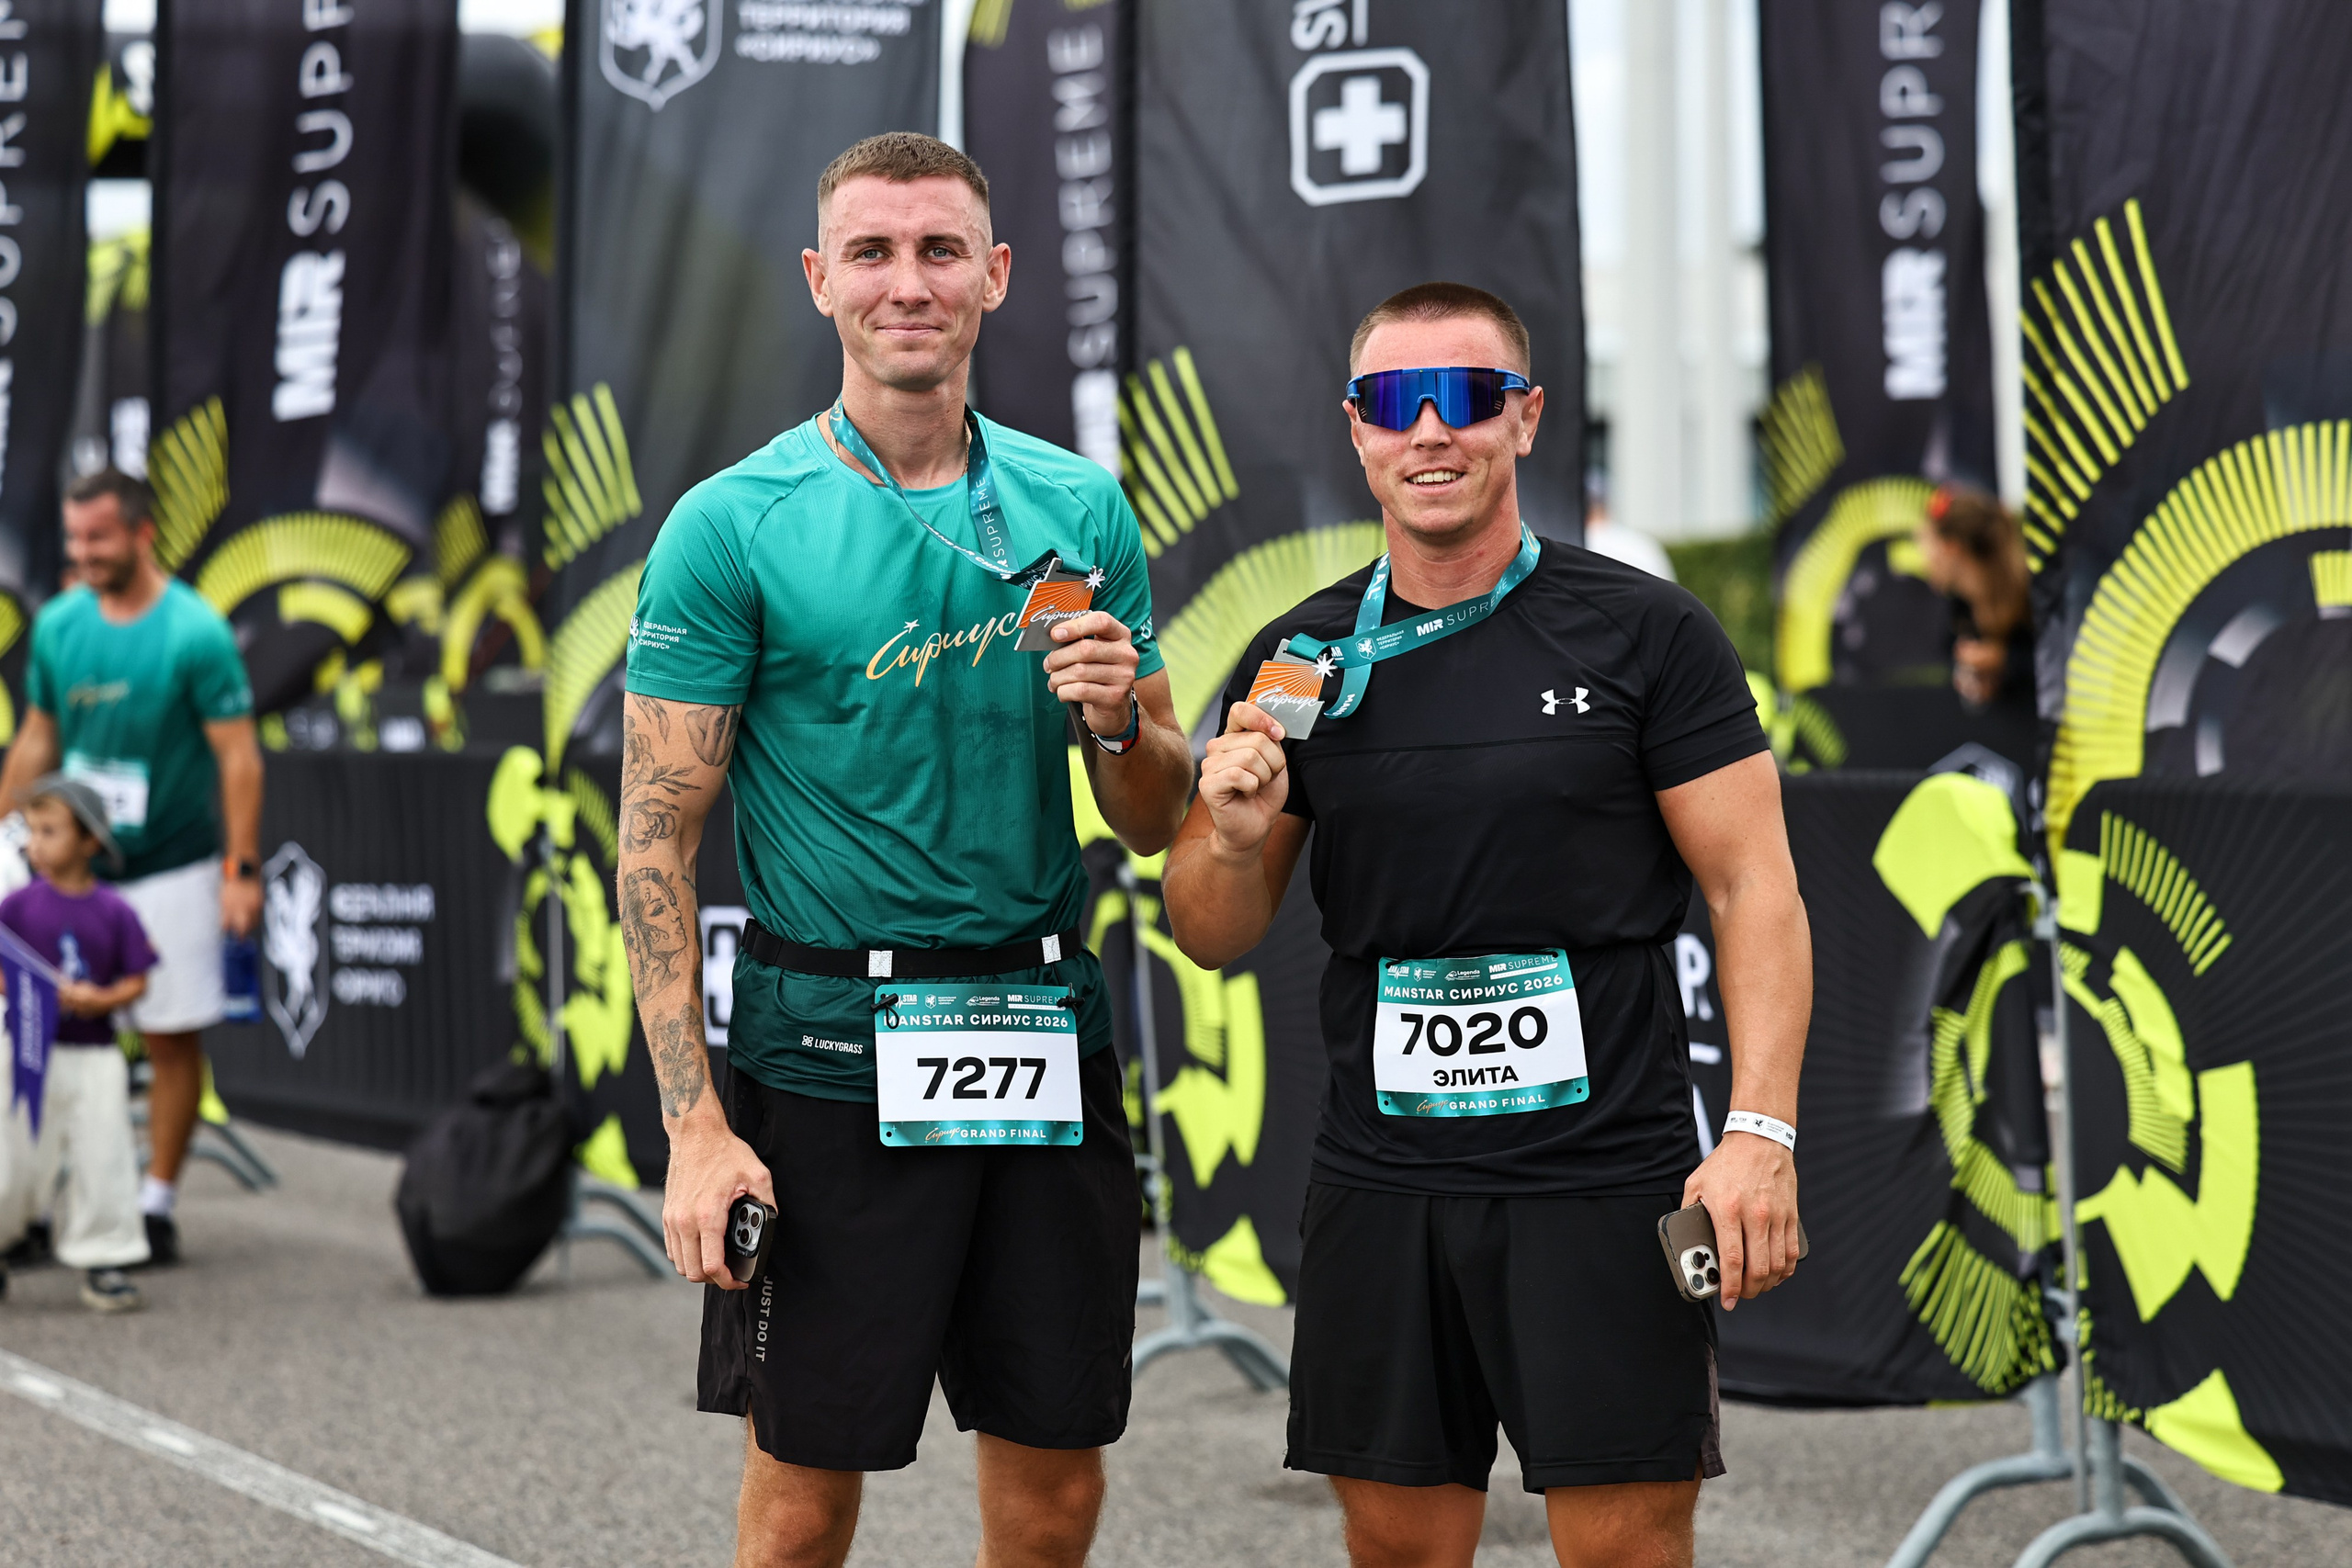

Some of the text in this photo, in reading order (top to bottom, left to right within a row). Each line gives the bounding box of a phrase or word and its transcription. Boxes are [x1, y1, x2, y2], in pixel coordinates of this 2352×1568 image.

[273, 248, 346, 422] MIR
[976, 476, 1005, 558] SUPREME
[1416, 577, 1507, 637] MIR SUPREME
[638, 637, 670, 649] СИРИУС»
[865, 612, 1018, 687] Сириус
[1255, 685, 1318, 713] Сириус
[1457, 969, 1480, 977] Legenda
[1488, 963, 1507, 974] MIR
[1508, 954, 1558, 970] SUPREME
[1007, 994, 1063, 1004] MIR SUPREM
[1384, 974, 1564, 1000] MANSTAR СИРИУС 2026
[883, 1013, 1069, 1028] MANSTAR СИРИУС 2026
[1400, 1006, 1548, 1057] 7020
[814, 1038, 864, 1055] LUCKYGRASS
[917, 1056, 1046, 1100] 7277
[1432, 1065, 1520, 1087] ЭЛИТА
[1449, 1100, 1498, 1111] GRAND
[1501, 1094, 1546, 1108] FINAL
[960, 1128, 1006, 1138] GRAND
[1011, 1128, 1046, 1138] FINAL
[755, 1275, 774, 1362] JUST DO IT
